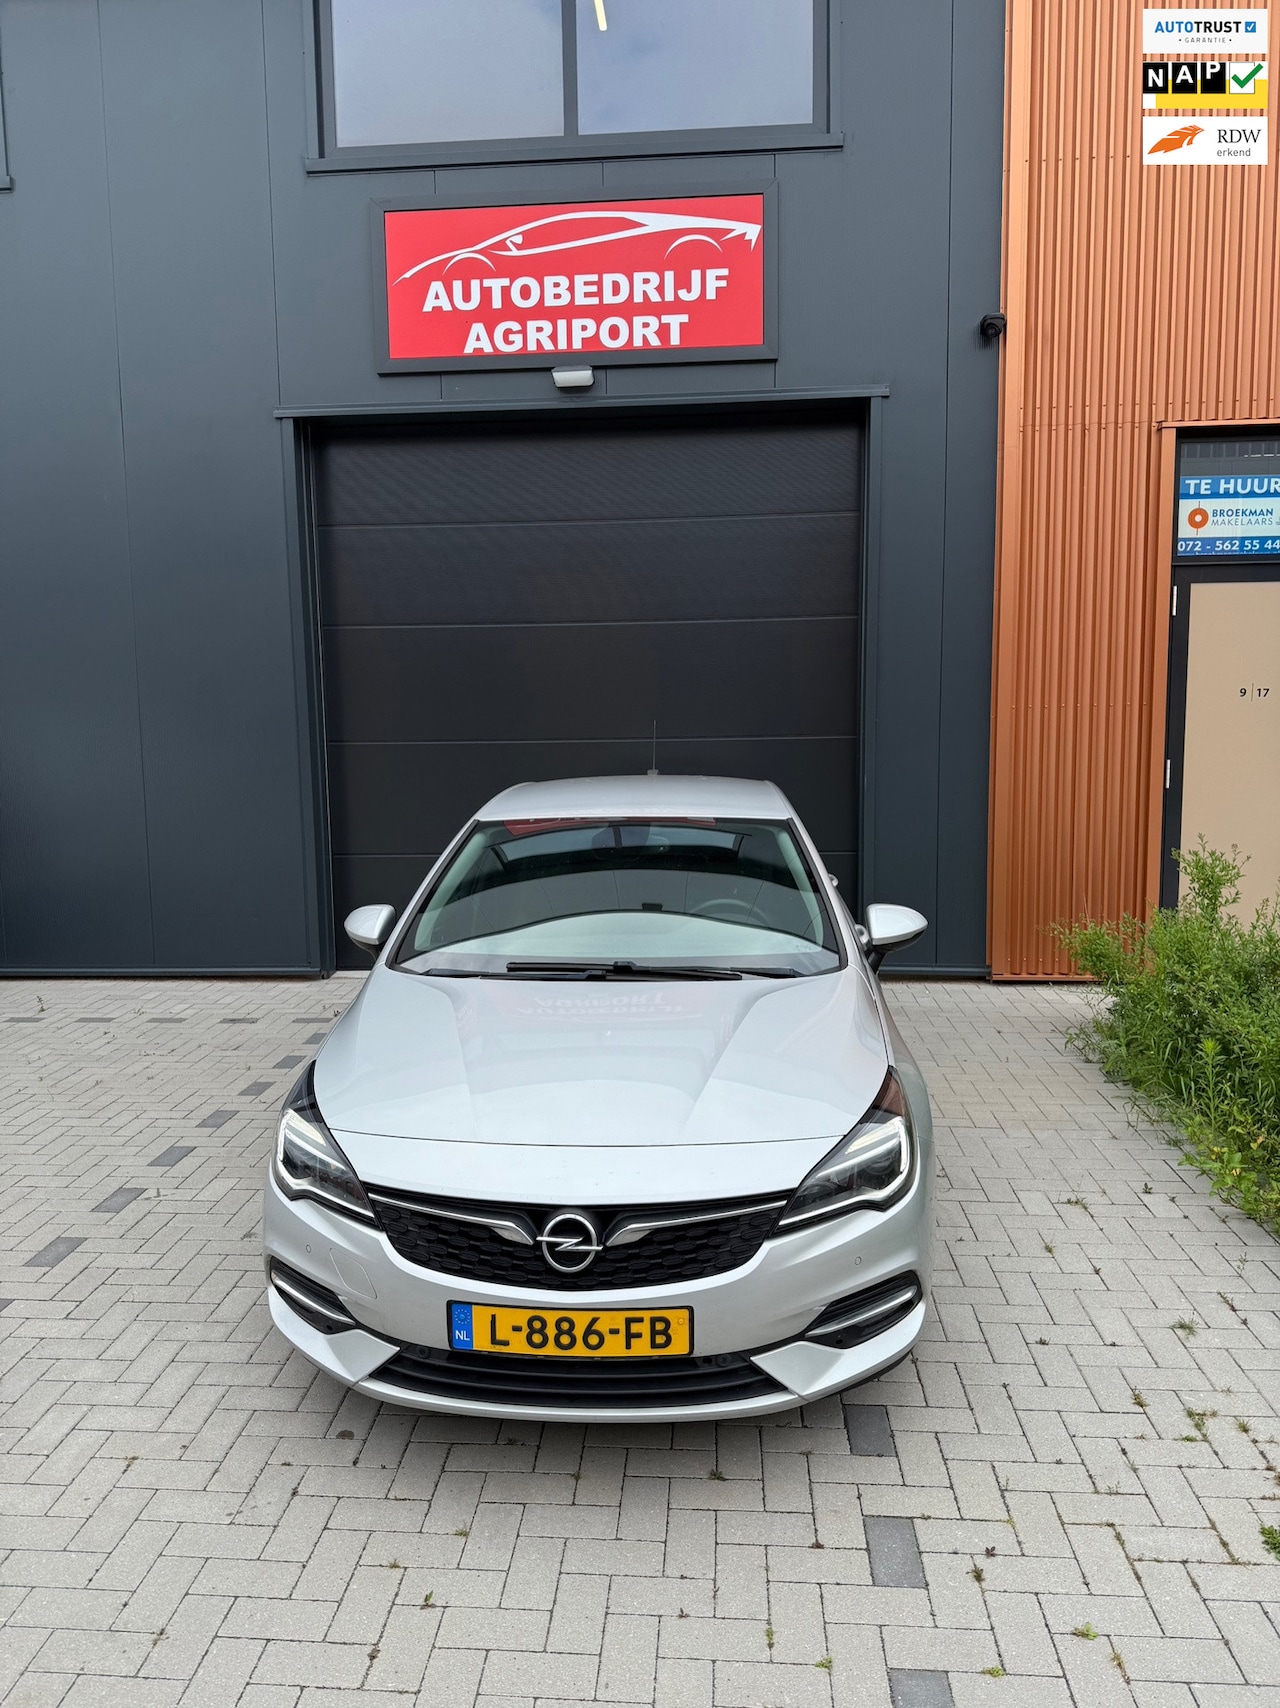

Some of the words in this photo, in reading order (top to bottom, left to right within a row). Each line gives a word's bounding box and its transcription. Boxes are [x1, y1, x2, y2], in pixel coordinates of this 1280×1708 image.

[422, 268, 730, 313] AUTOBEDRIJF
[463, 314, 690, 354] AGRIPORT
[1185, 480, 1212, 495] TE
[1220, 478, 1280, 494] HUUR
[1211, 517, 1273, 526] MAKELAARS
[1212, 508, 1274, 518] BROEKMAN
[1177, 541, 1202, 551] 072
[1215, 541, 1240, 550] 562
[1244, 540, 1260, 550] 55
[455, 1330, 470, 1341] NL
[490, 1313, 672, 1351] L-886-FB
